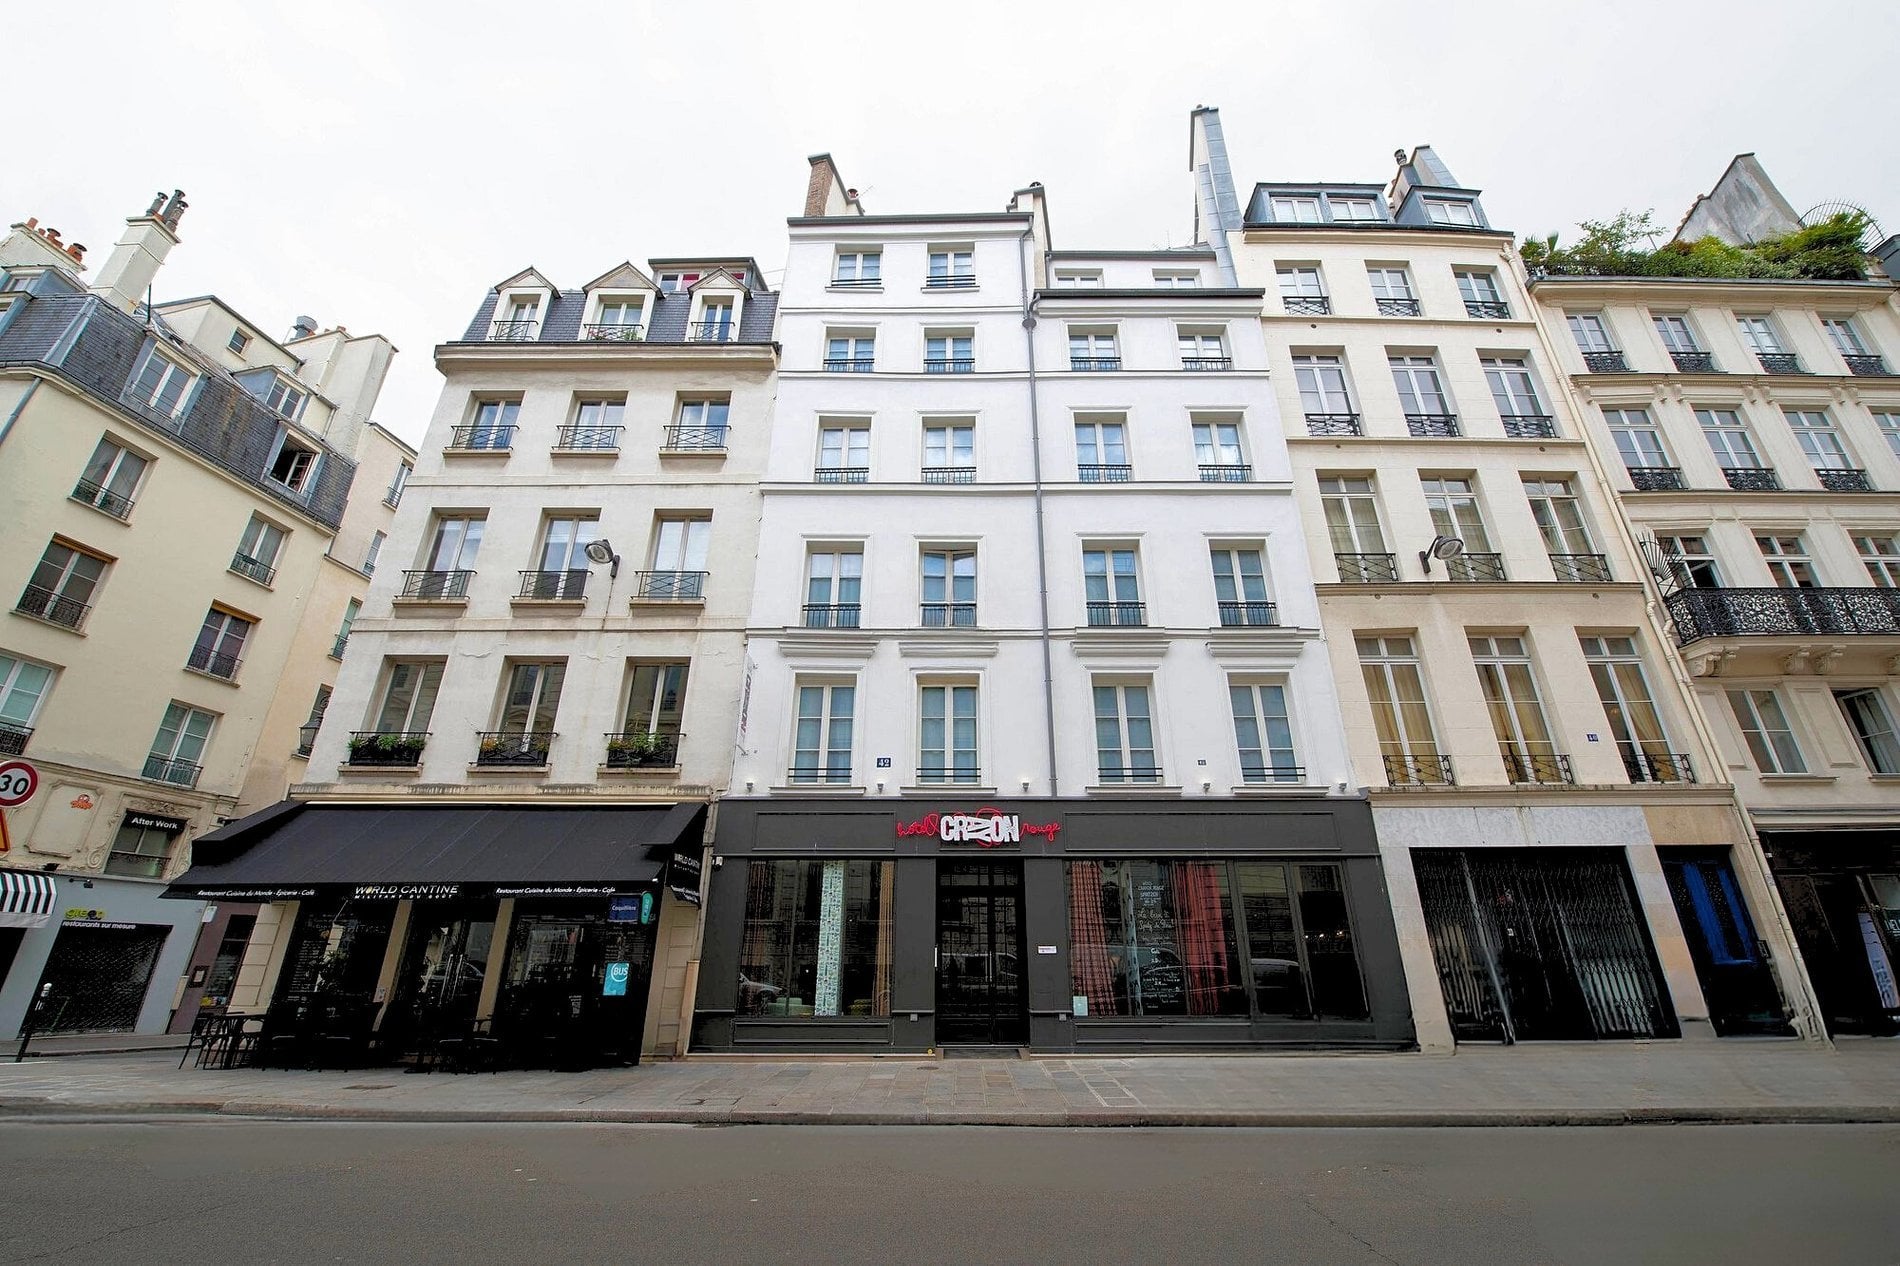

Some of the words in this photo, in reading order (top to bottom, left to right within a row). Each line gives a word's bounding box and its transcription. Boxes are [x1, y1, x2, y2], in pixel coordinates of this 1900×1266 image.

[878, 758, 890, 767] 42
[0, 774, 29, 796] 30
[131, 817, 154, 826] After
[155, 820, 178, 830] Work
[1020, 822, 1061, 842] rouge
[400, 885, 460, 894] CANTINE
[613, 967, 628, 976] BUS
